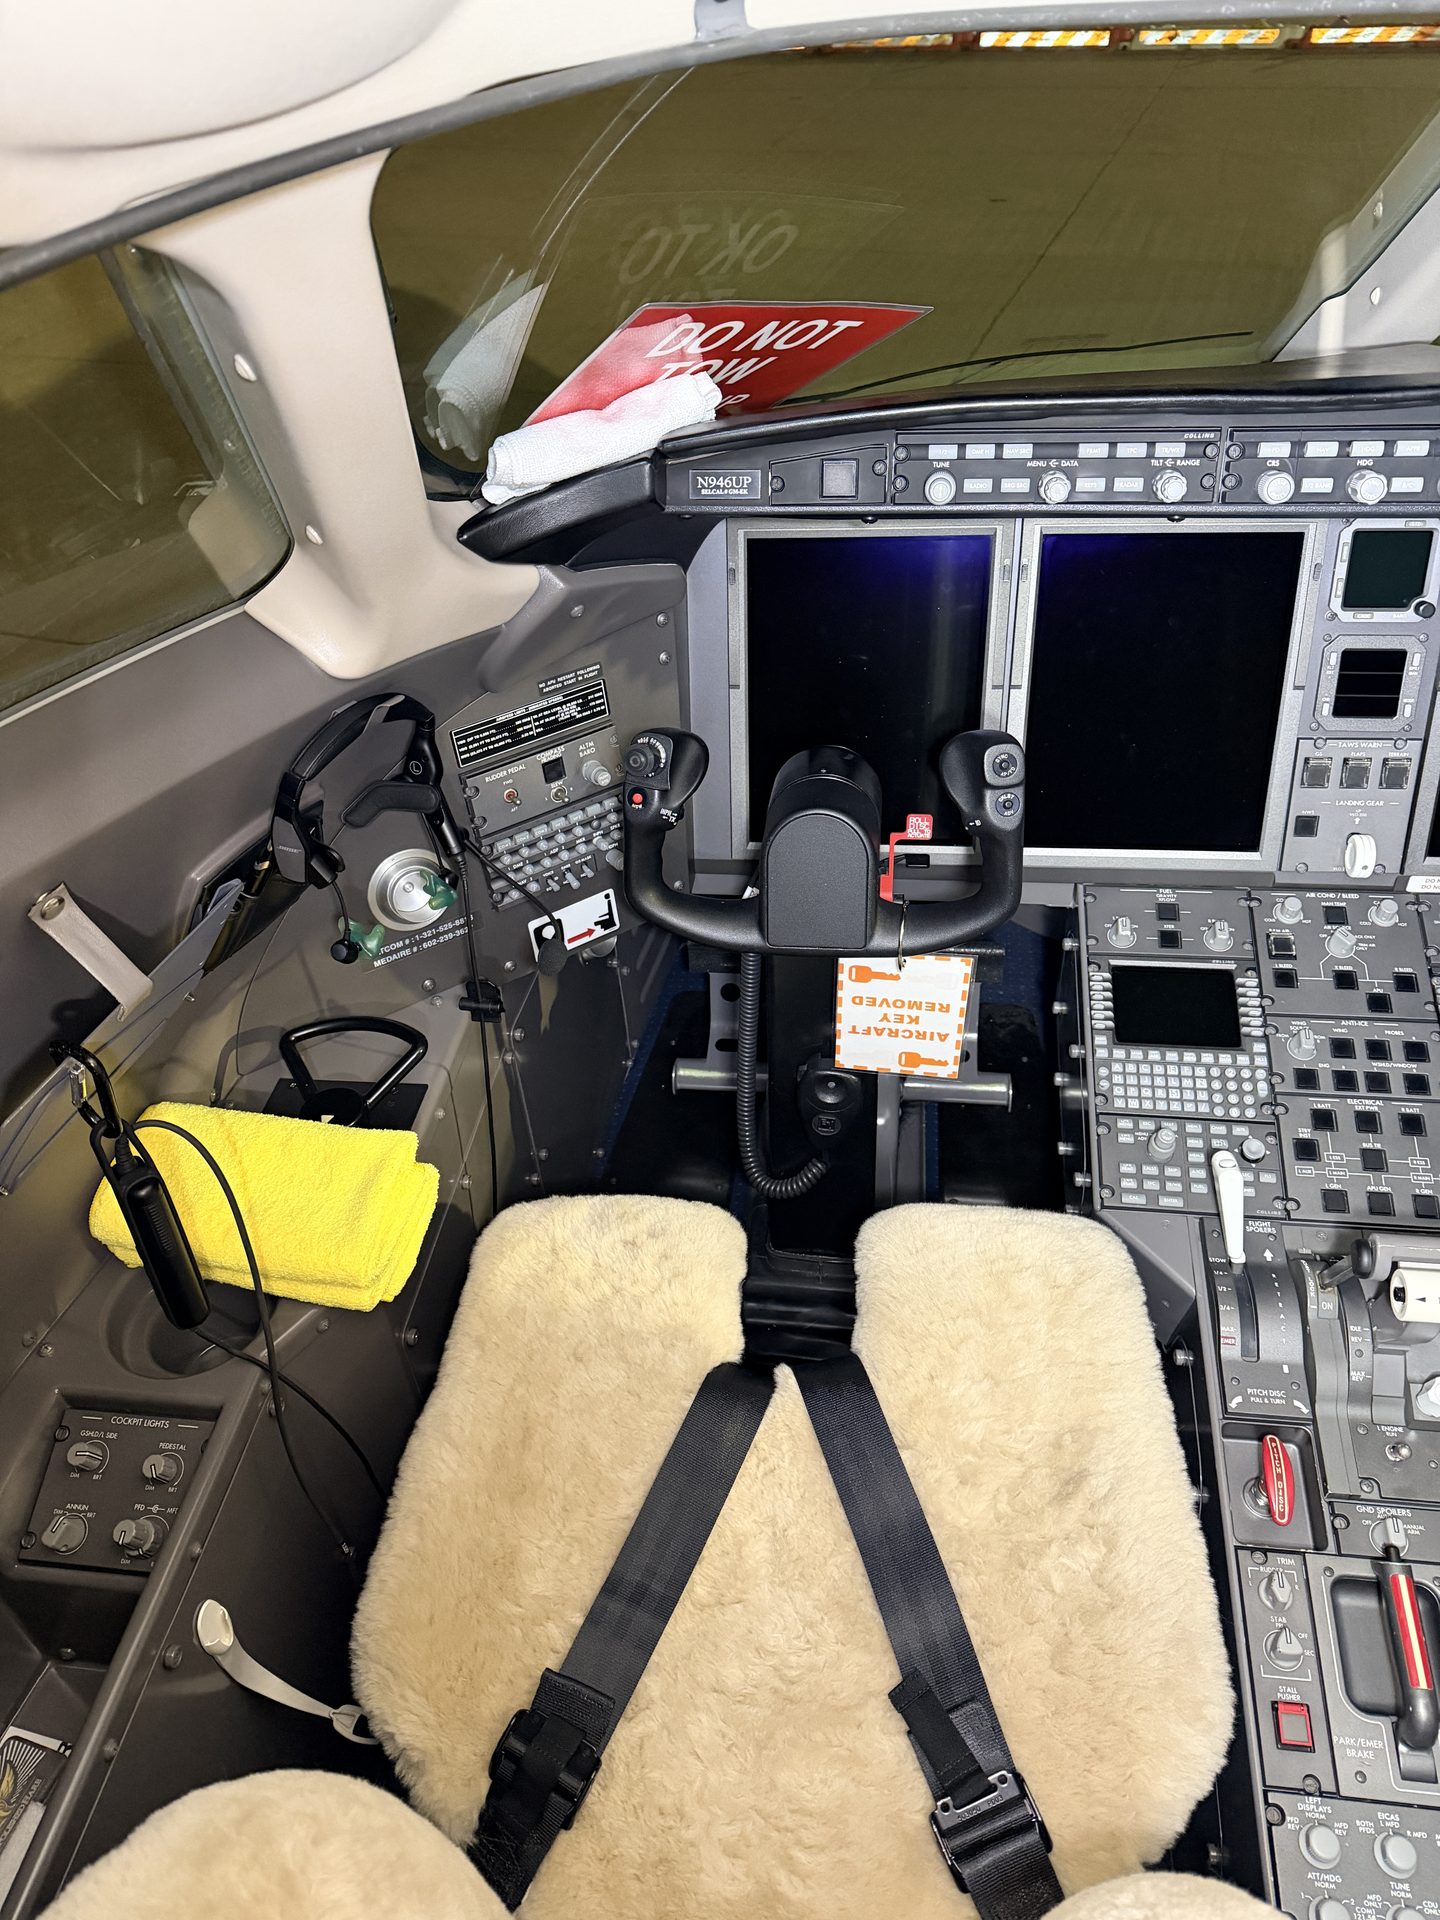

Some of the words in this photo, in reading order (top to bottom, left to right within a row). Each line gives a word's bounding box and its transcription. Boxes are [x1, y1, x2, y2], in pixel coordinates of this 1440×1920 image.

[646, 320, 745, 358] DO
[732, 319, 864, 352] NOT
[658, 356, 778, 385] TOW
[696, 476, 752, 488] N946UP
[558, 672, 576, 683] RESTART
[577, 664, 600, 675] FOLLOWING
[543, 682, 562, 693] ABORTED
[564, 676, 576, 686] START
[584, 670, 598, 679] FLIGHT
[578, 741, 594, 751] ALTM
[536, 746, 565, 760] COMPASS
[579, 748, 596, 758] BARO
[485, 769, 508, 783] RUDDER
[508, 764, 526, 776] PEDAL
[374, 949, 412, 968] MEDAIRE
[422, 928, 468, 949] 602-239-362
[851, 996, 950, 1013] REMOVED
[878, 1013, 920, 1024] KEY
[848, 1025, 950, 1042] AIRCRAFT
[1321, 1301, 1334, 1310] ON
[1247, 1388, 1268, 1396] PITCH
[111, 1416, 143, 1427] COCKPIT
[144, 1419, 170, 1429] LIGHTS
[106, 1431, 118, 1440] SIDE
[159, 1442, 187, 1451] PEDESTAL
[1271, 1442, 1282, 1474] PITCH
[1356, 1505, 1375, 1514] GND
[1377, 1506, 1411, 1517] SPOILERS
[1276, 1558, 1296, 1566] TRIM
[1277, 1693, 1301, 1701] PUSHER
[1334, 1736, 1384, 1749] PARK/EMER
[1346, 1750, 1375, 1759] BRAKE
[1297, 1804, 1332, 1814] DISPLAYS
[1377, 1812, 1400, 1821] EICAS
[1307, 1872, 1342, 1883] ATT/HDG
[1315, 1881, 1336, 1890] NORM
[1390, 1882, 1411, 1891] TUNE
[1391, 1890, 1412, 1899] NORM
[1364, 1900, 1383, 1908] ONLY
[1356, 1907, 1376, 1915] COM1
